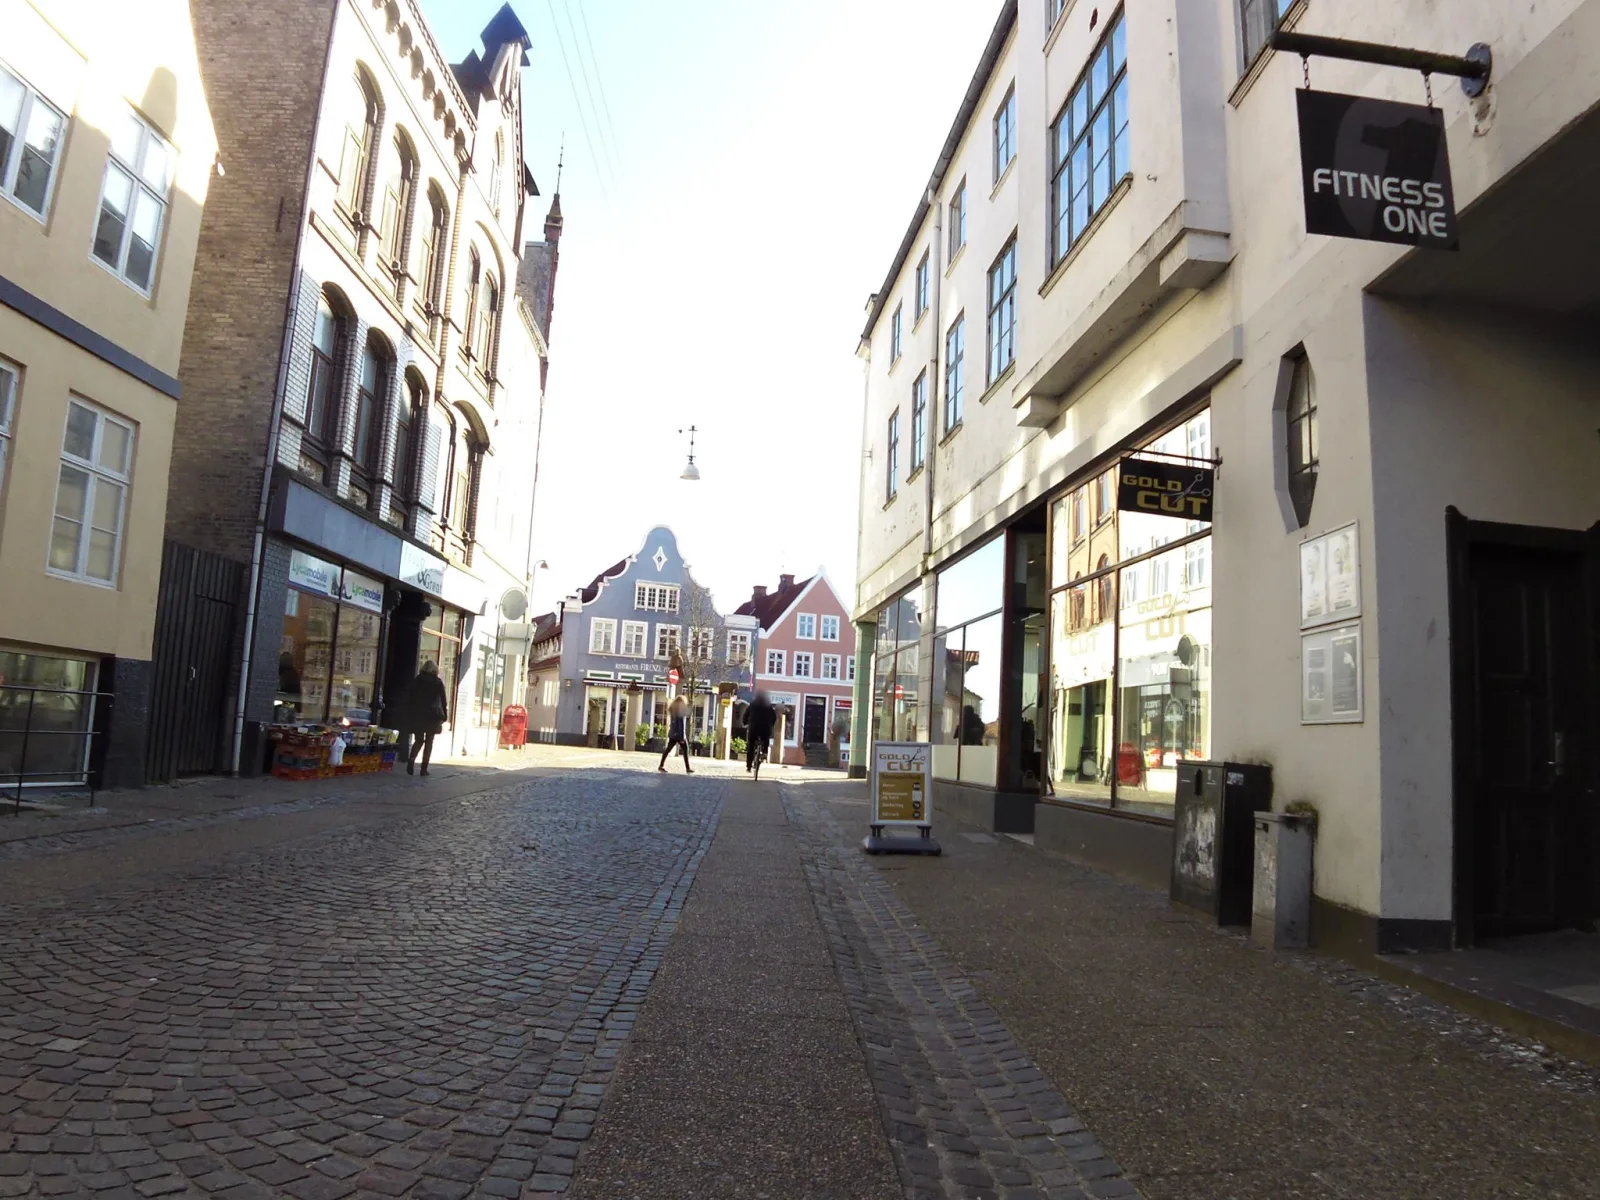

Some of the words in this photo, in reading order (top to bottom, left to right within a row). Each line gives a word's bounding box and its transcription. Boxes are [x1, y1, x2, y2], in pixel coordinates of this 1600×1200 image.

[1312, 167, 1445, 209] FITNESS
[1382, 205, 1448, 238] ONE
[1122, 474, 1182, 492] GOLD
[1136, 490, 1208, 515] CUT
[351, 581, 382, 603] Lycamobile
[1138, 593, 1172, 614] GOLD
[1146, 609, 1188, 641] CUT
[640, 663, 661, 673] FIRENZE
[887, 761, 925, 771] CUT
